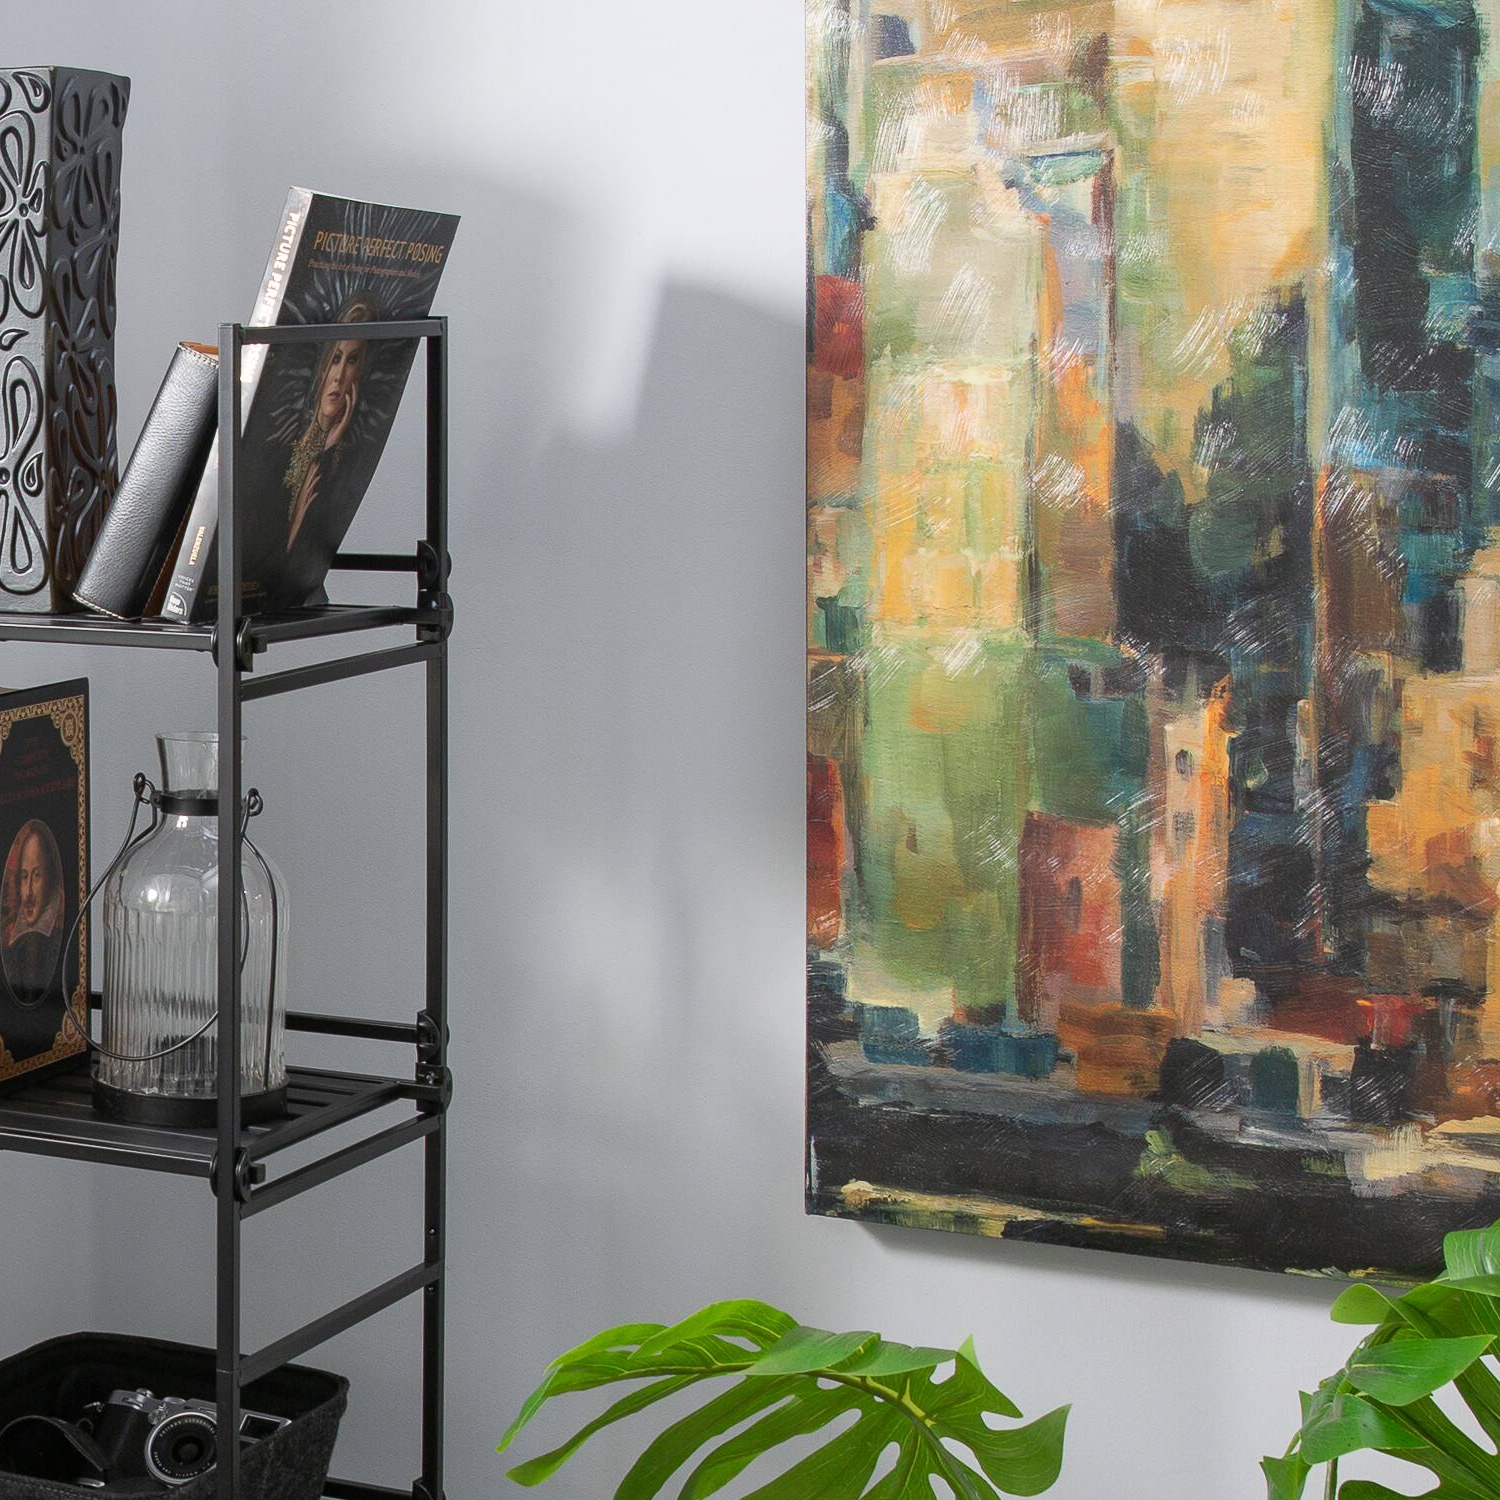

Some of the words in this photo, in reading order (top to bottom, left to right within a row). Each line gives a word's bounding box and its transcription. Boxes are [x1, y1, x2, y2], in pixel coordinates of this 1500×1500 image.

[274, 211, 301, 271] PICTURE
[313, 231, 361, 256] PICTURE
[362, 237, 408, 260] PERFECT
[406, 242, 445, 264] POSING
[189, 526, 206, 566] VALENZUELA
